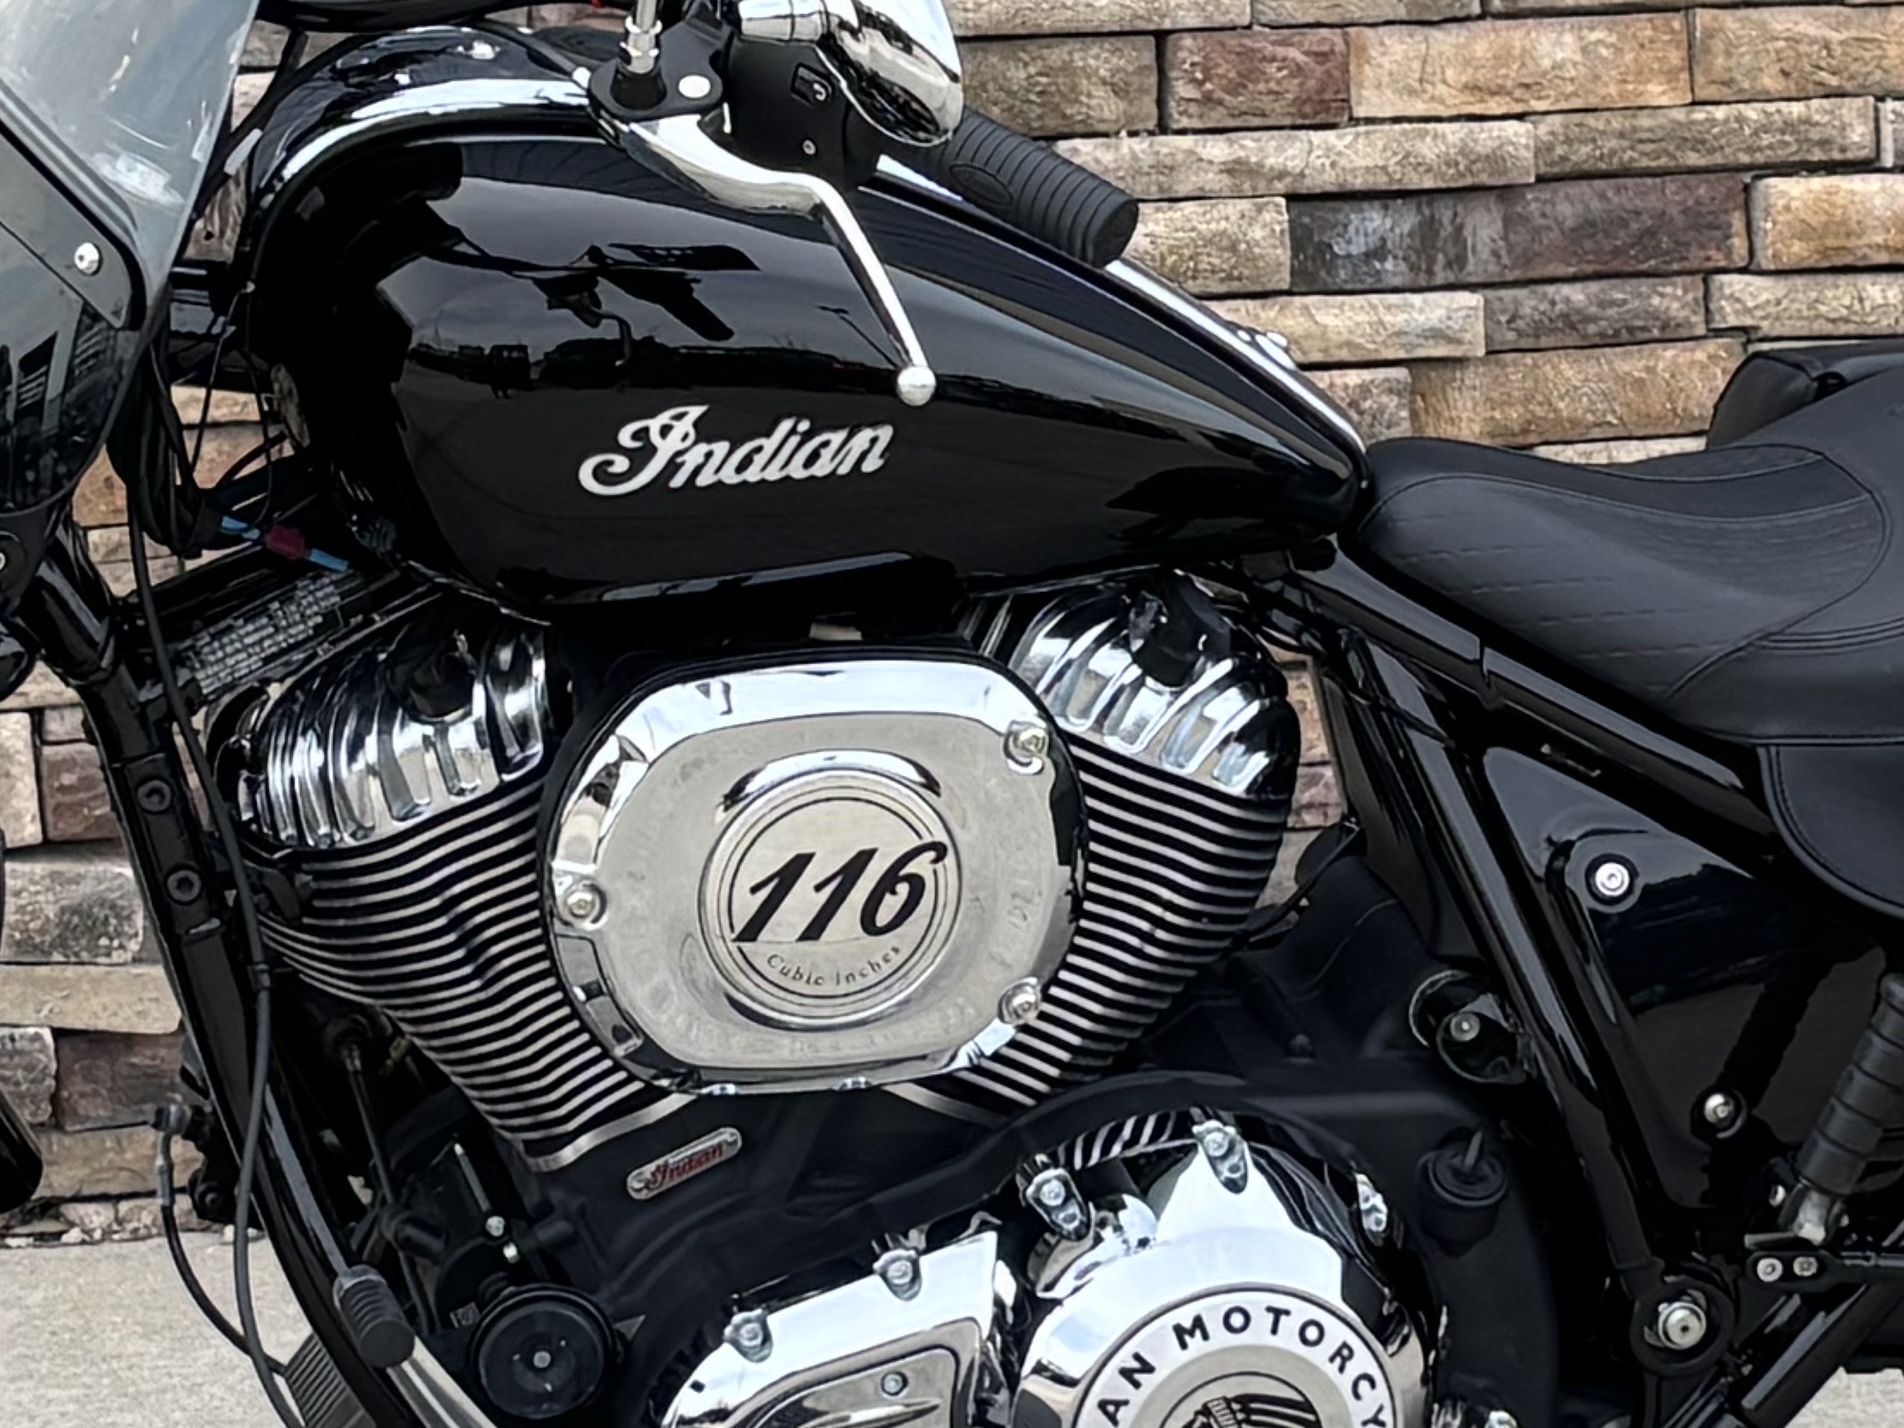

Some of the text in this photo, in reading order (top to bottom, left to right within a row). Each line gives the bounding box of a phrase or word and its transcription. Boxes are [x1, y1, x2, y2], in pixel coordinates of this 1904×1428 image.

[578, 404, 895, 497] Indian
[731, 838, 948, 944] 116
[766, 953, 825, 986] Cubic
